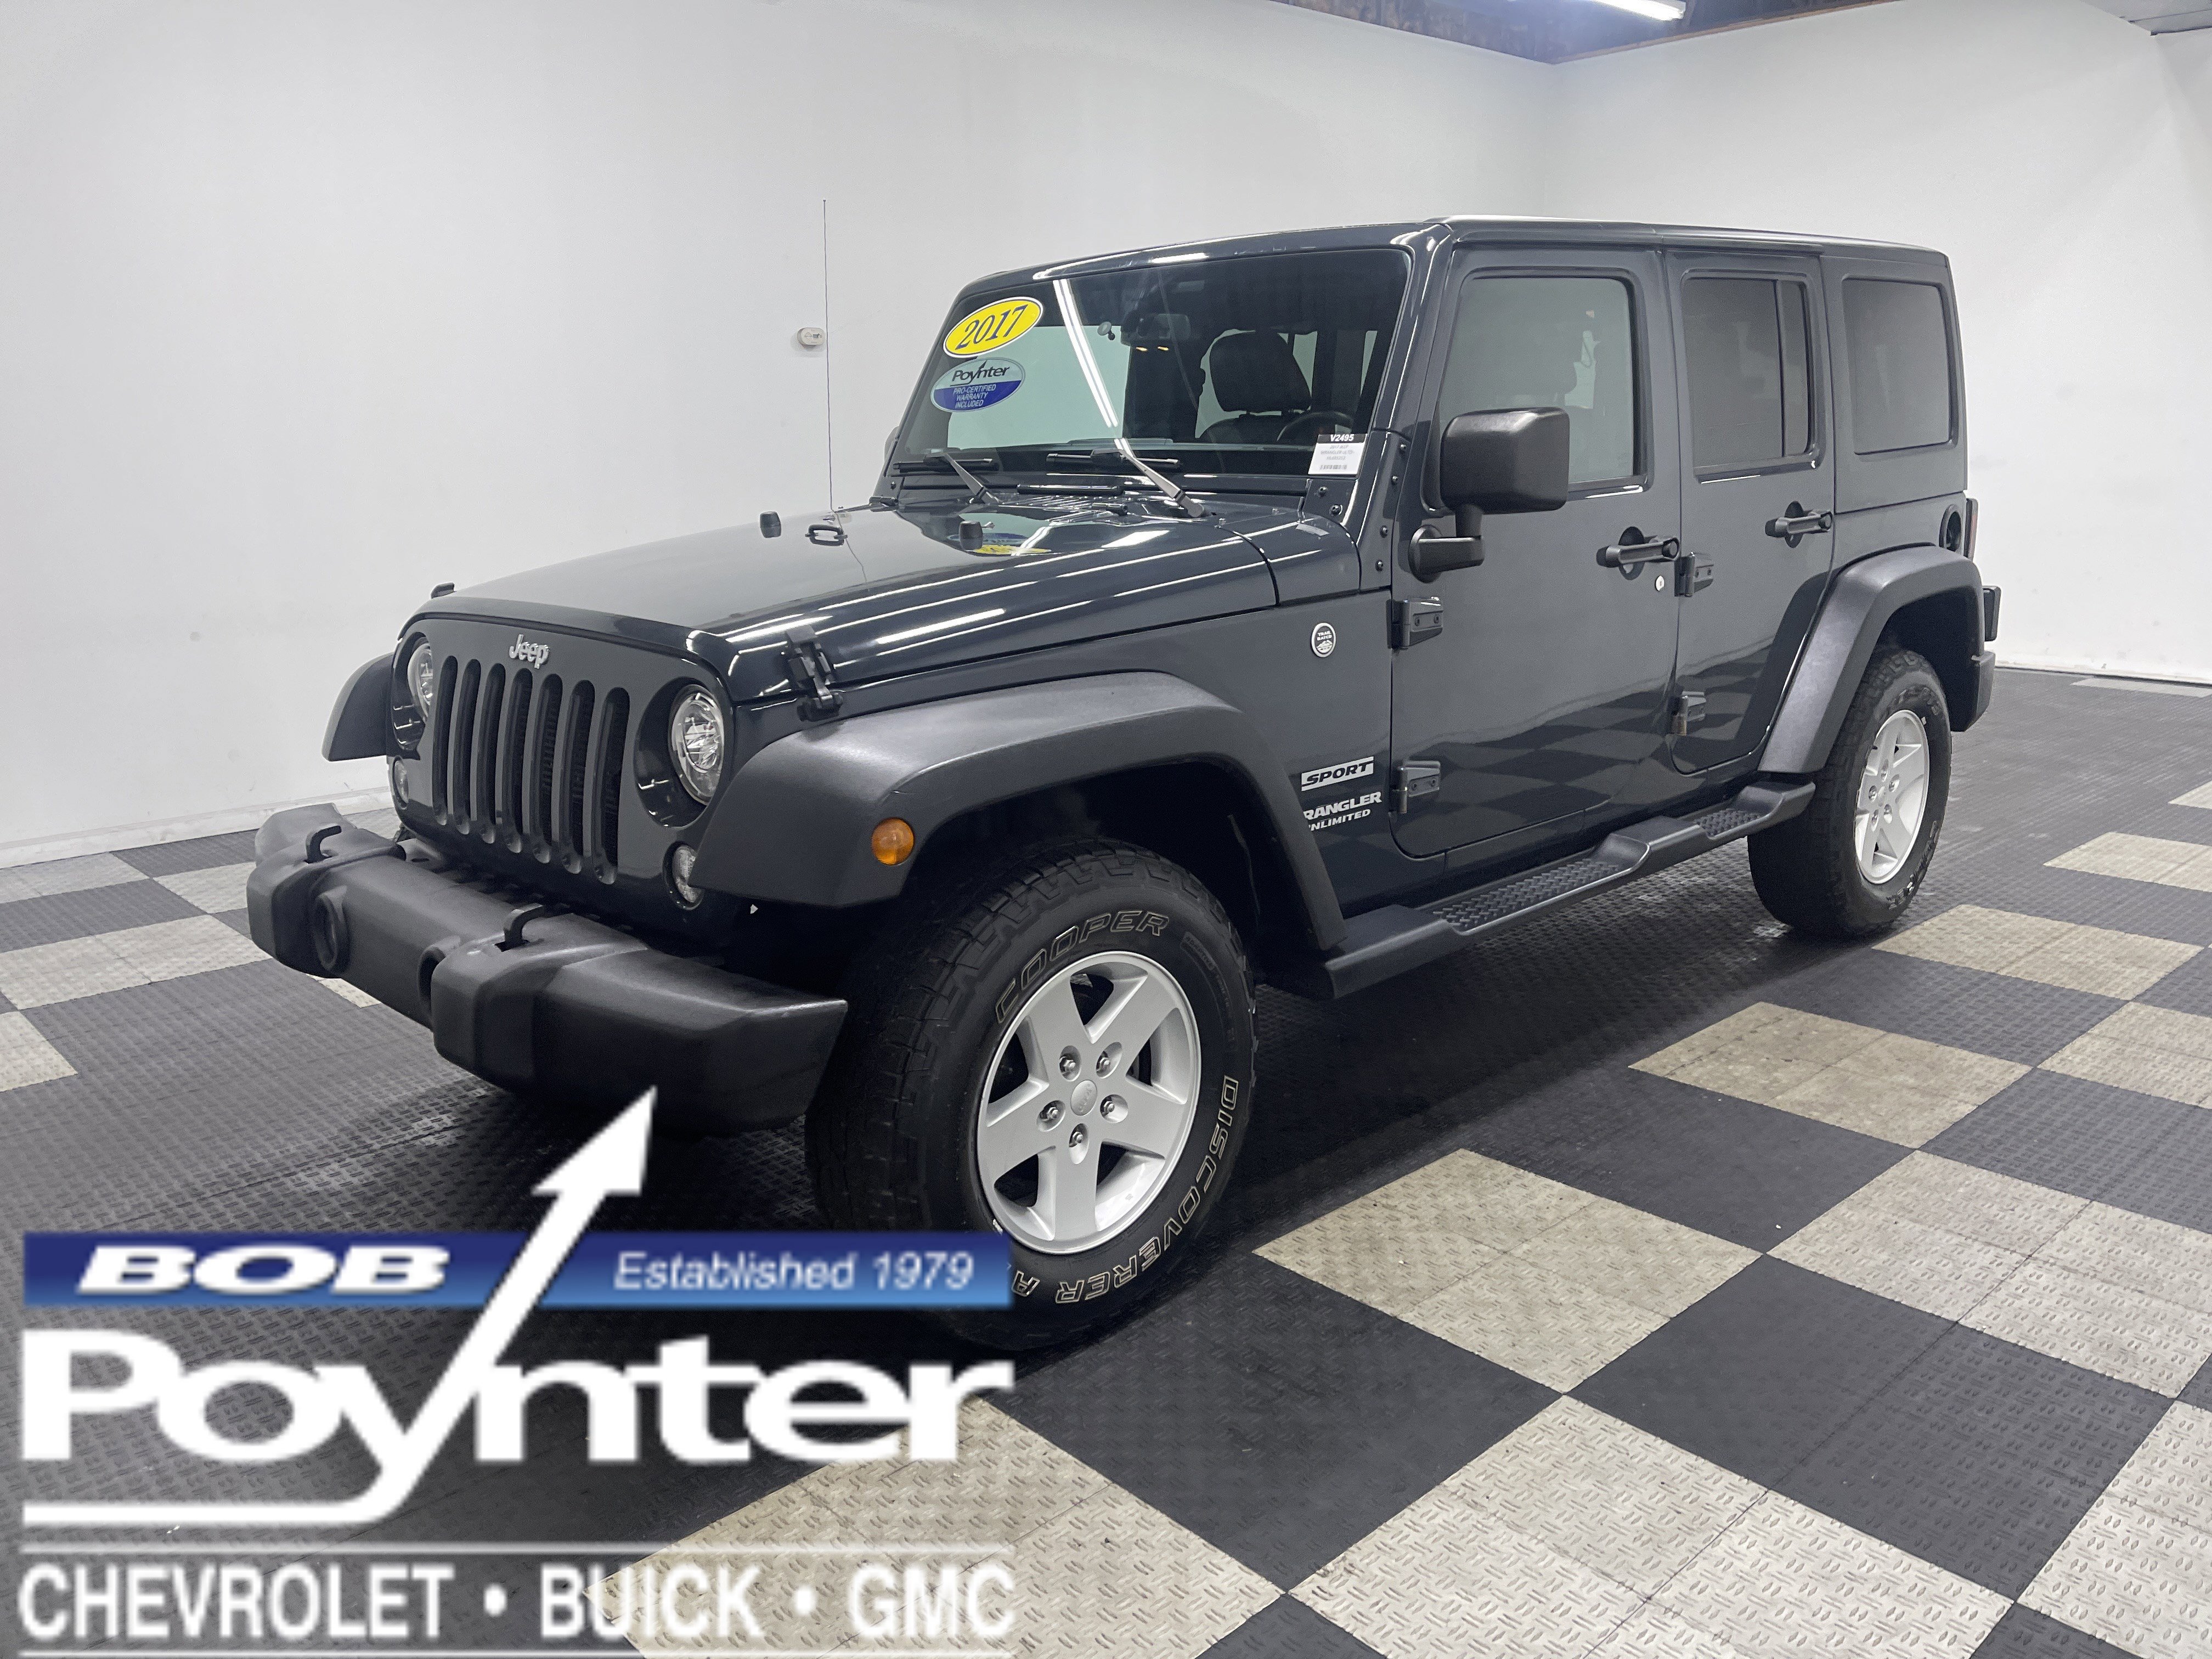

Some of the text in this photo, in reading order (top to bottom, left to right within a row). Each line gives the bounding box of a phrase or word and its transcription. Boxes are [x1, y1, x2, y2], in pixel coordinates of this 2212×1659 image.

[955, 304, 1029, 351] 2017
[950, 362, 1011, 387] Poynter
[953, 383, 997, 395] PRO-CERTIFIED
[956, 392, 989, 402] WARRANTY
[955, 399, 984, 409] INCLUDED
[1330, 433, 1355, 442] V2495
[509, 634, 549, 669] Jeep
[1306, 761, 1372, 785] SPORT
[1308, 809, 1372, 832] NLIMITED
[995, 910, 1170, 1024] COOPER
[1055, 1075, 1239, 1304] DISCOVERER
